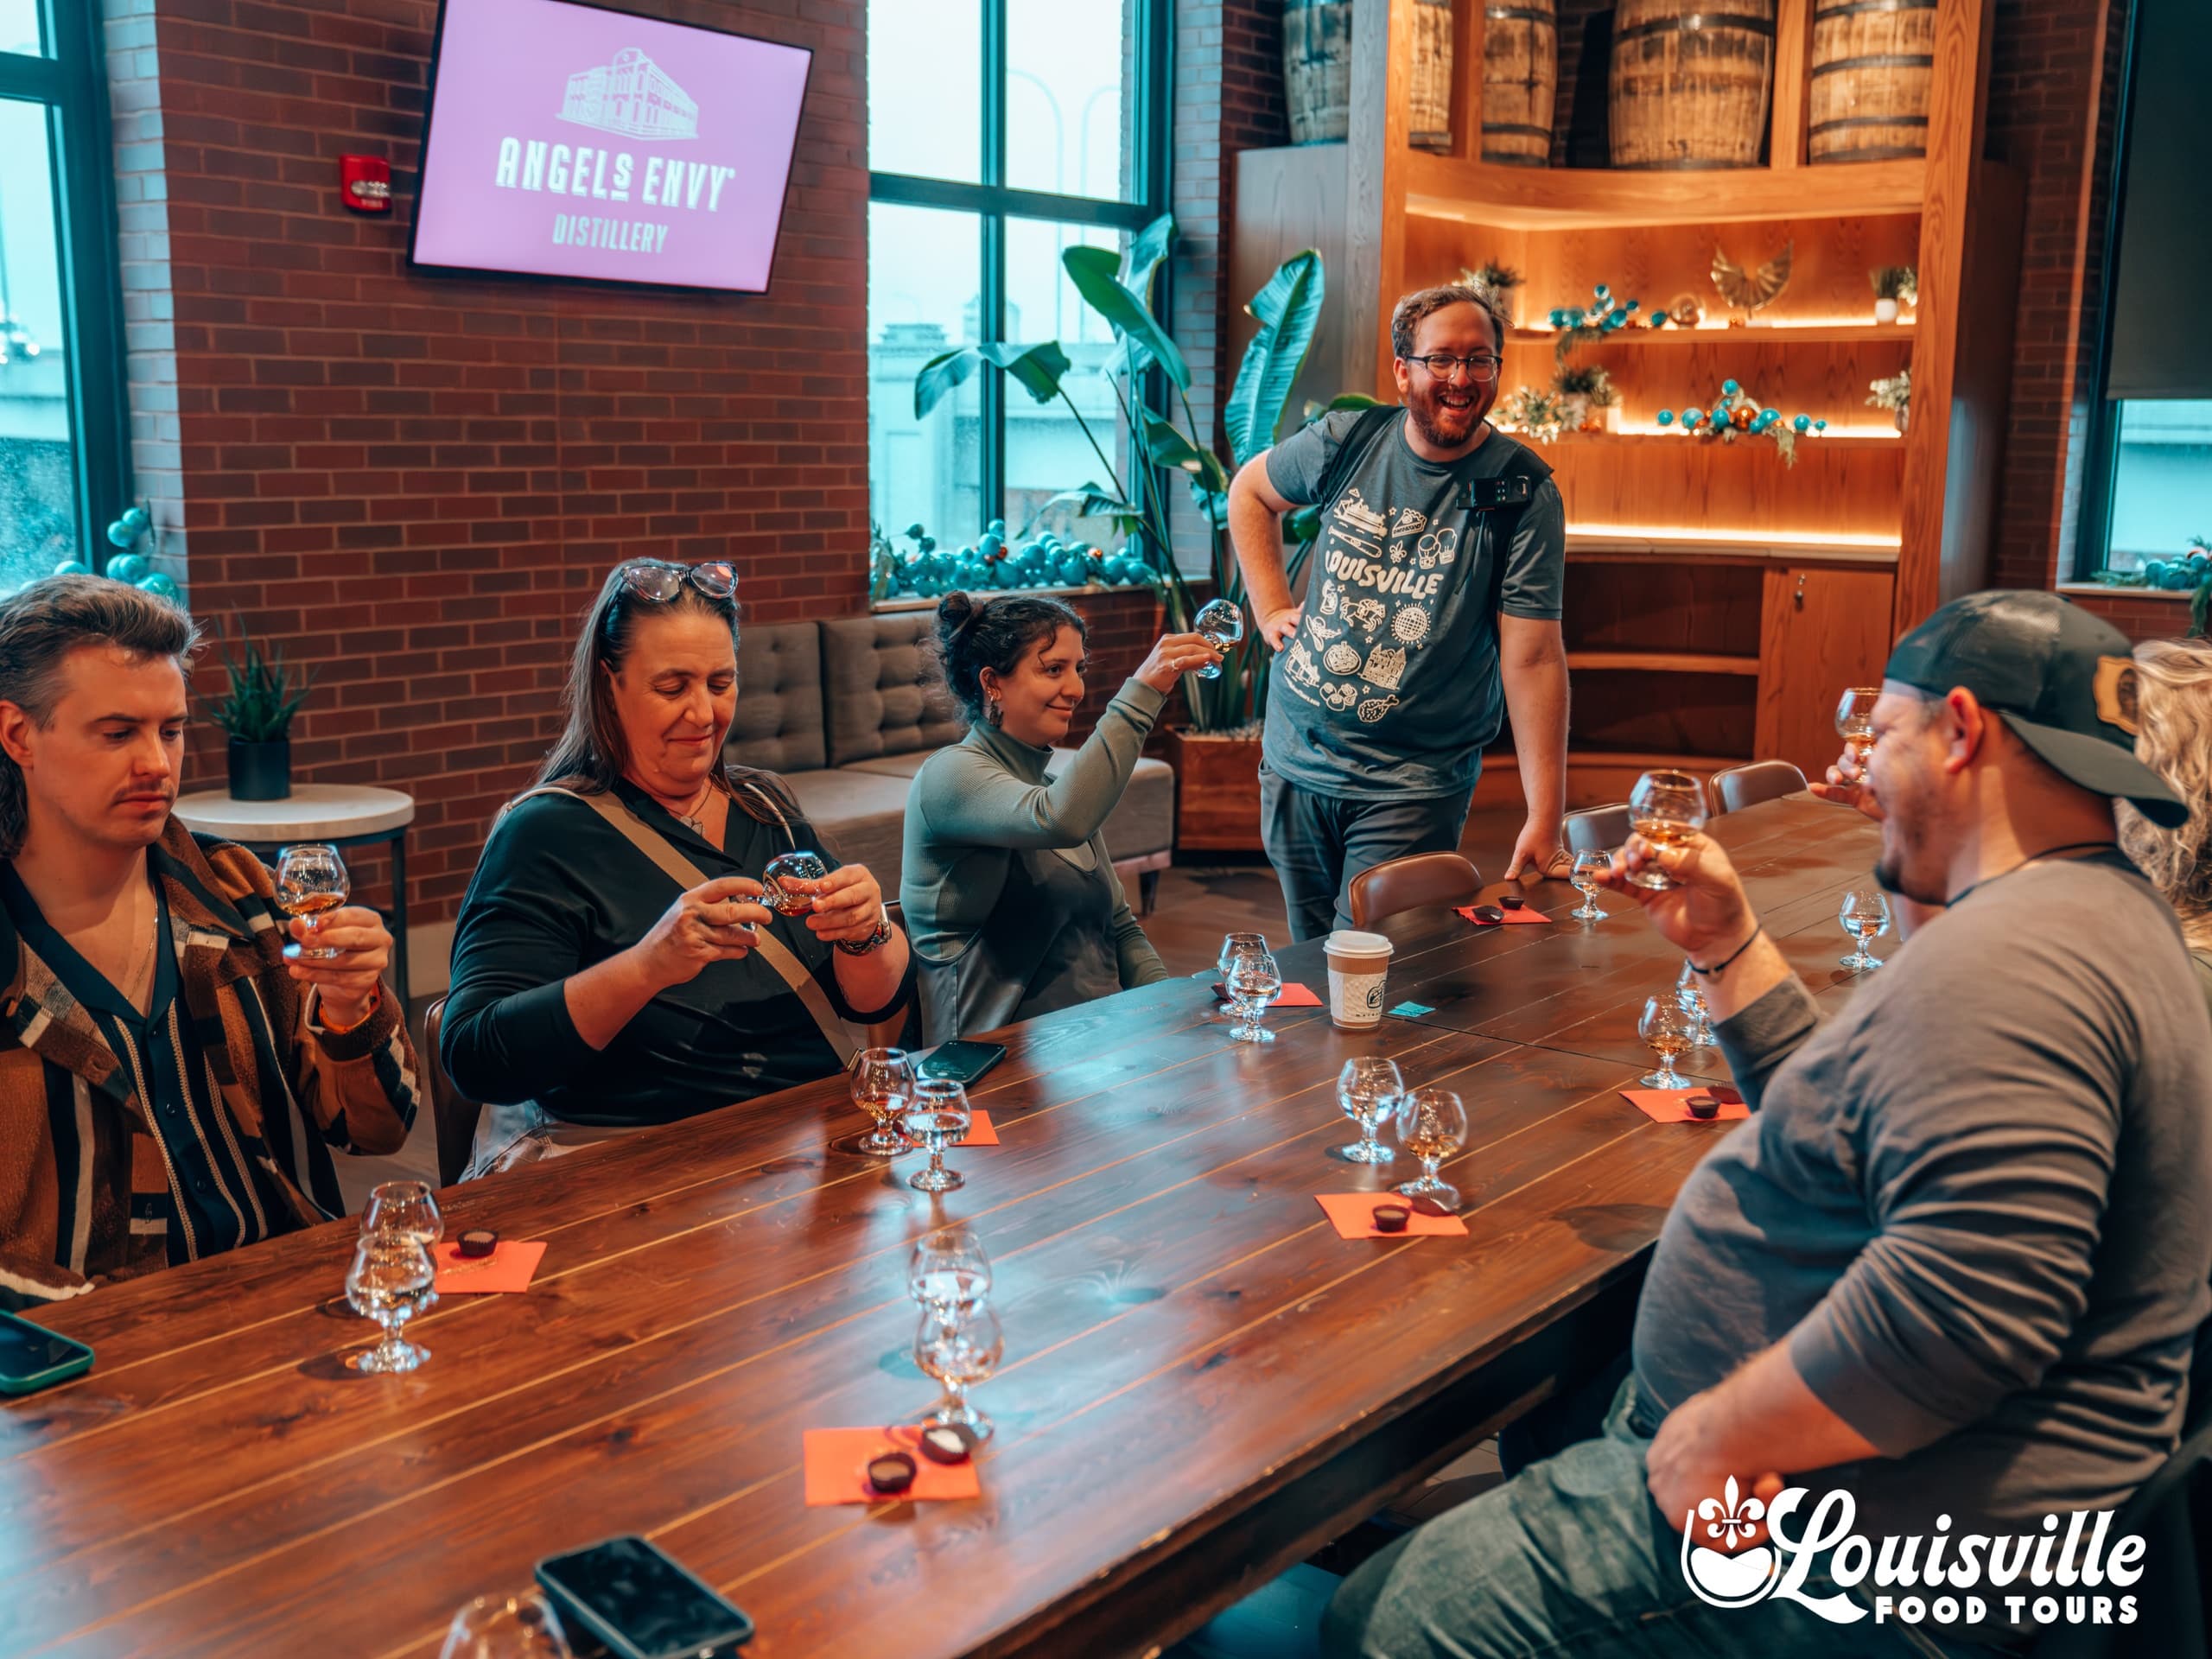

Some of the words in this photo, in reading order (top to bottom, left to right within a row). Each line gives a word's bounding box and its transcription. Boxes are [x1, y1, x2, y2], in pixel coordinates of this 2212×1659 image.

[495, 137, 634, 202] ANGELS
[642, 156, 728, 212] ENVY
[552, 213, 668, 253] DISTILLERY
